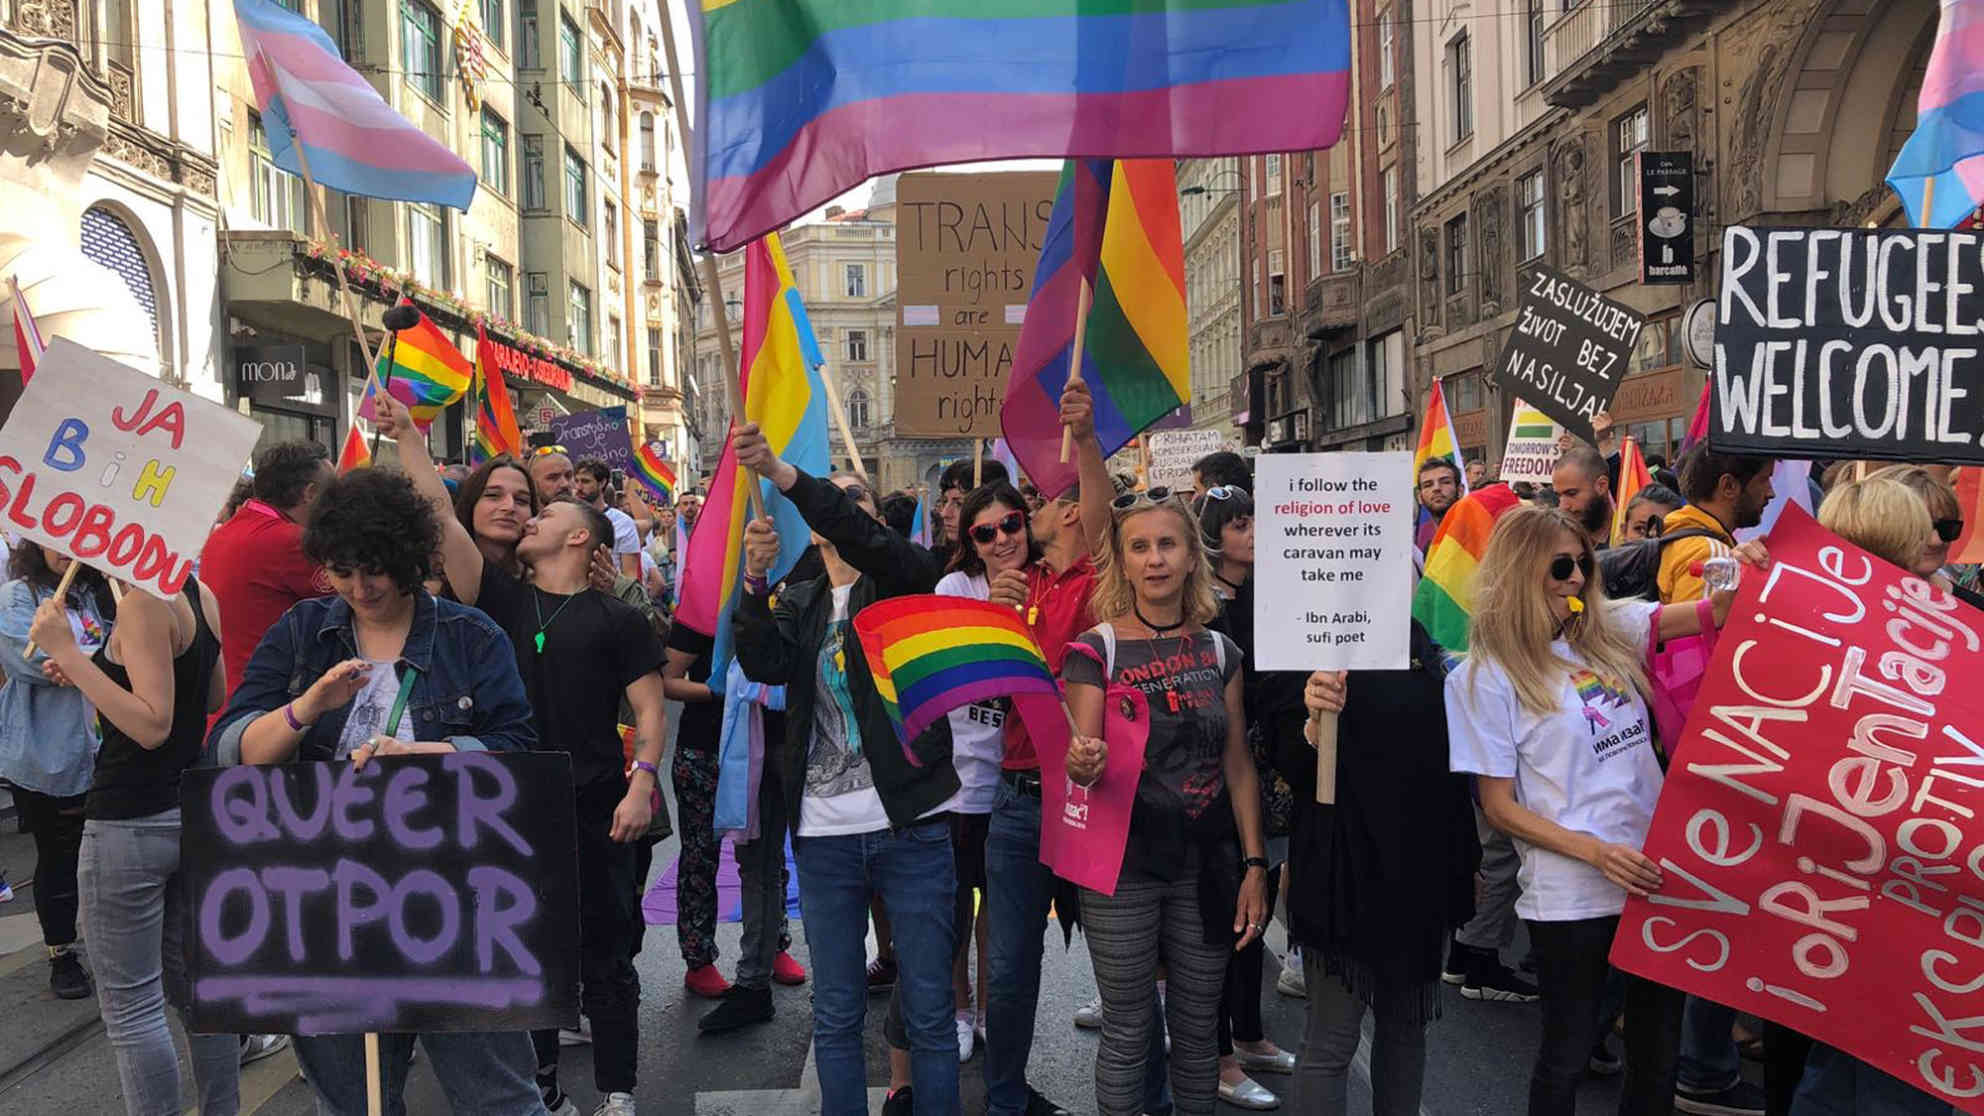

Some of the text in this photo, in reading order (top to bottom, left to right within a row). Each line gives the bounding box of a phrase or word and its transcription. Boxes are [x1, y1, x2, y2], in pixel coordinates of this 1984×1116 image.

[904, 200, 1054, 252] TRANS
[944, 260, 1025, 305] rights
[1720, 225, 1984, 335] REFUGEE
[954, 309, 990, 326] are
[1530, 271, 1642, 348] ZASLUŽUJEM
[911, 338, 1013, 379] HUMA
[1518, 305, 1618, 380] ŽIVOT BEZ
[112, 388, 185, 450] JA
[938, 384, 1005, 433] right
[1289, 478, 1378, 492] i follow the
[1274, 501, 1391, 517] religion of love
[1284, 522, 1382, 537] wherever its
[1283, 548, 1382, 561] caravan may
[1301, 568, 1364, 582] take me
[1306, 611, 1328, 624] Ibn
[1332, 610, 1372, 625] Arabi,
[1306, 631, 1365, 646] sufi poet
[1120, 651, 1195, 684] ONDON
[211, 751, 534, 857] QUEER
[201, 858, 543, 976] OTPOR
